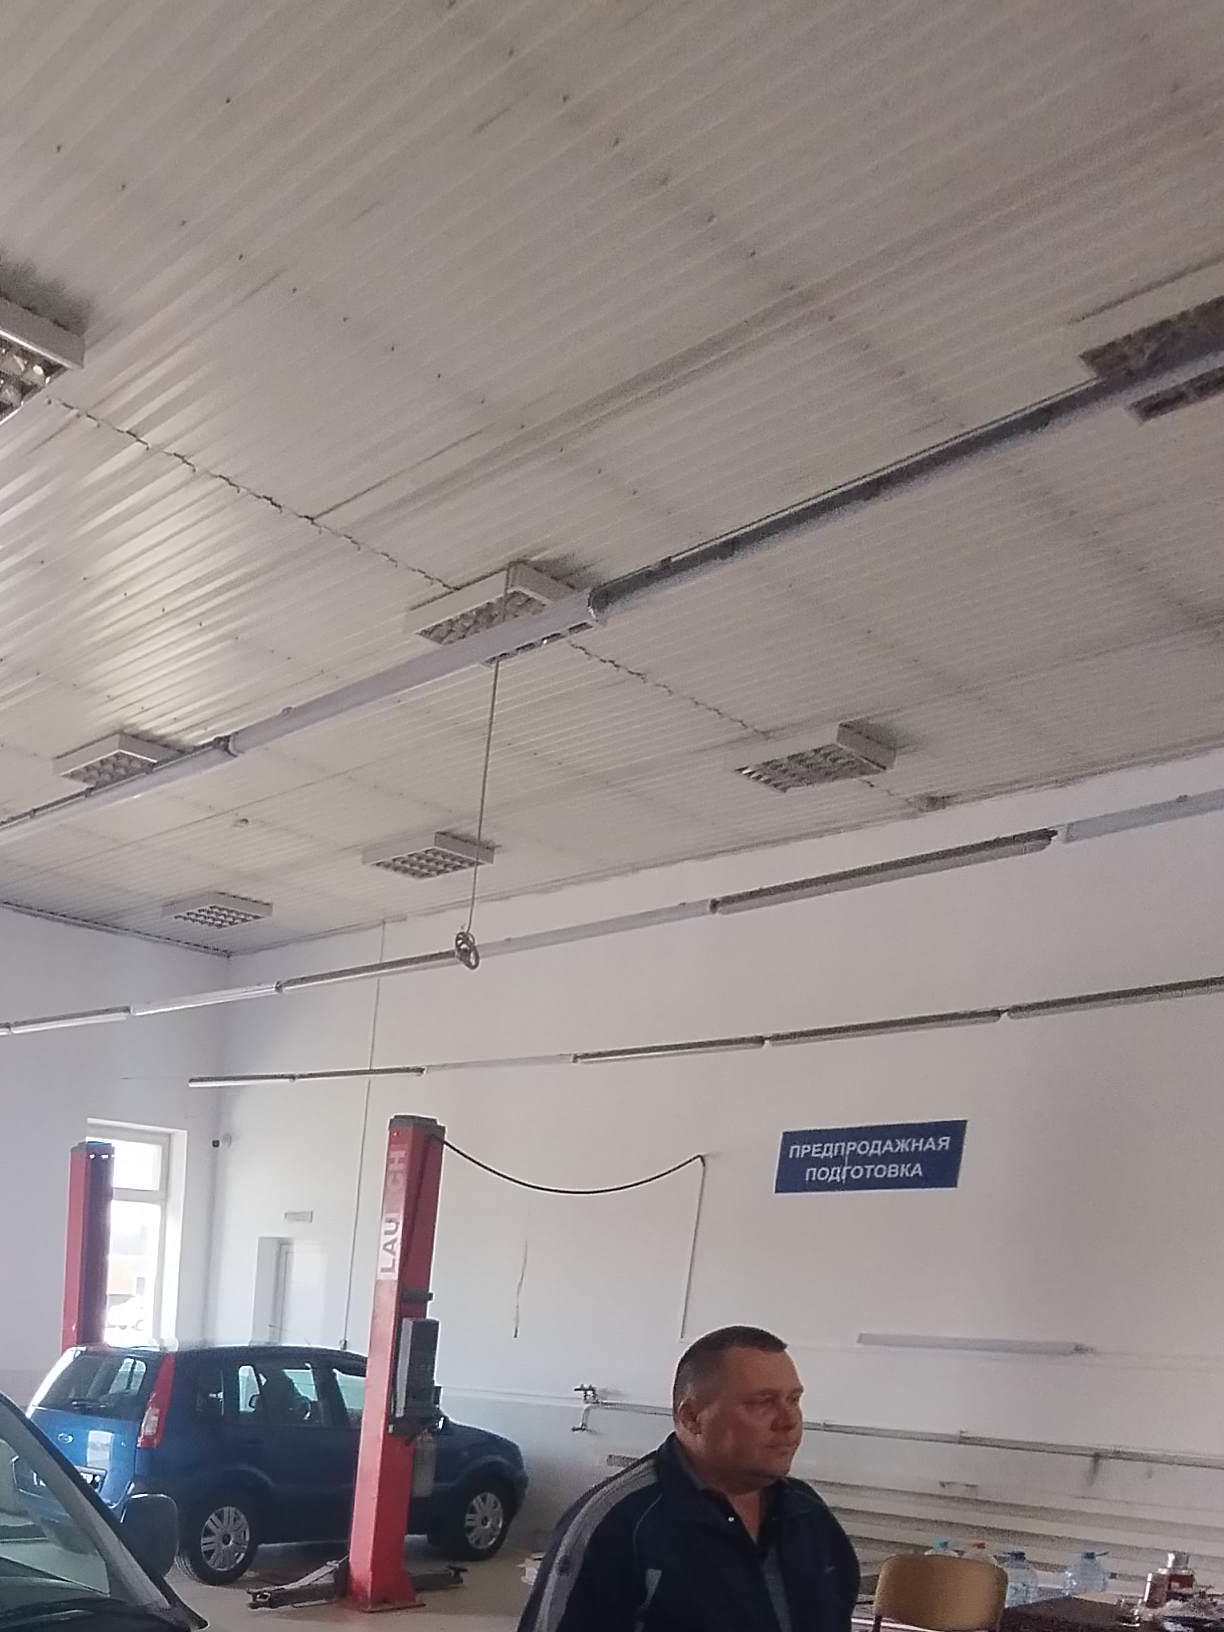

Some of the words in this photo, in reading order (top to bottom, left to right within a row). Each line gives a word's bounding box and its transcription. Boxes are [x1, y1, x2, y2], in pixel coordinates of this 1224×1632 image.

[789, 1136, 951, 1159] ПРЕДПРОДАЖНАЯ
[805, 1163, 923, 1184] ПОДГОТОВКА
[380, 1151, 406, 1274] LAUCH
